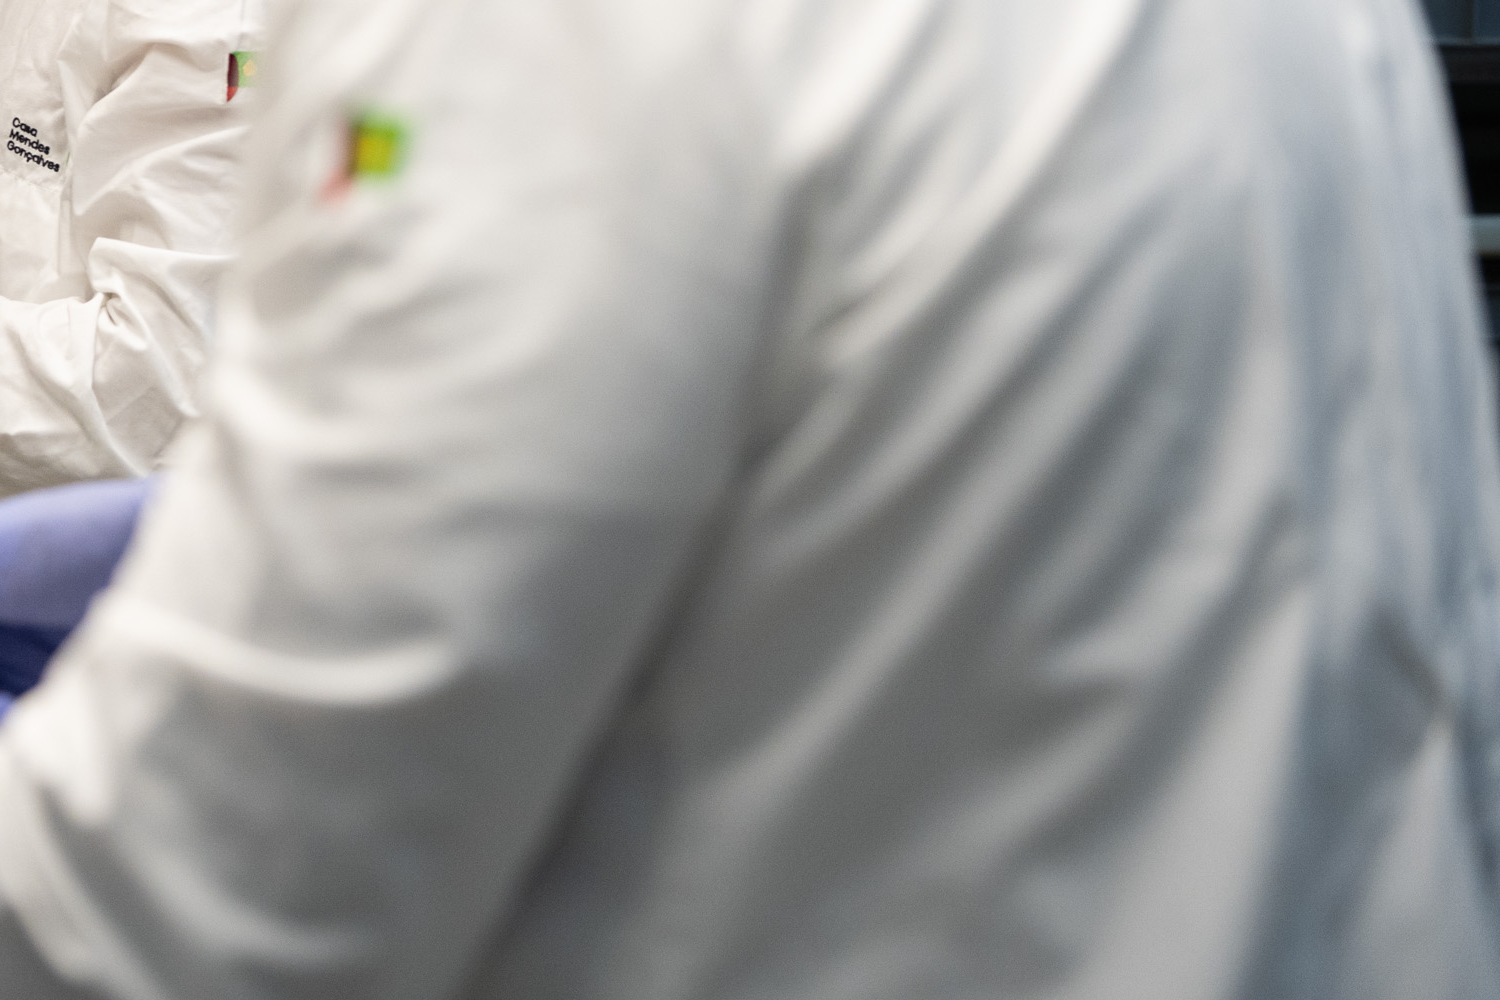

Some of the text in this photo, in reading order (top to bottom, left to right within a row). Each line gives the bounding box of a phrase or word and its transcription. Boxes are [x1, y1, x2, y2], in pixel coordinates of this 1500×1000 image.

[12, 117, 38, 137] Casa
[9, 128, 50, 155] Mendes
[7, 140, 60, 172] Gonçalves
